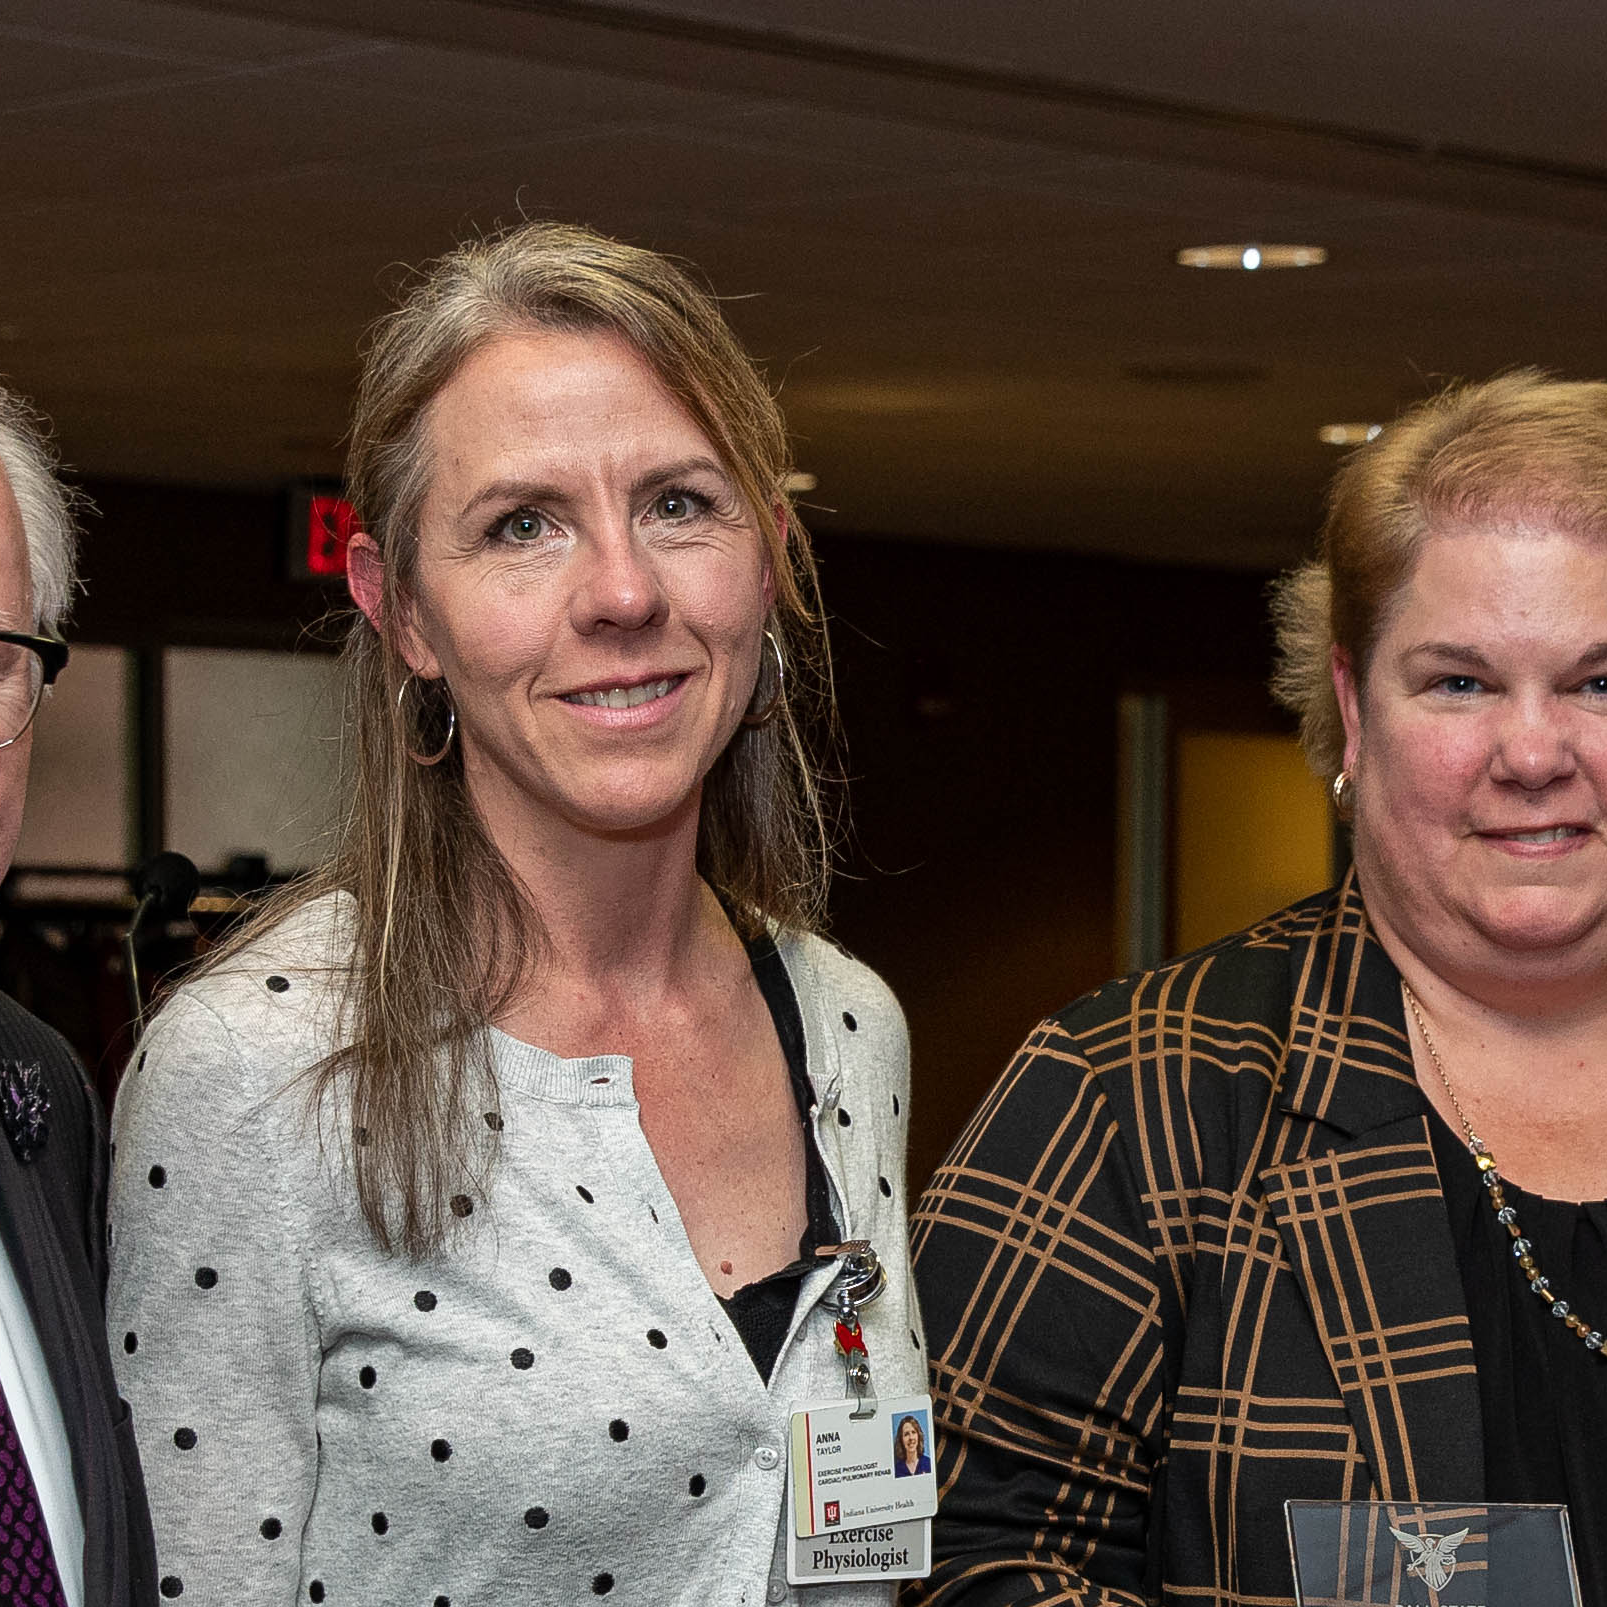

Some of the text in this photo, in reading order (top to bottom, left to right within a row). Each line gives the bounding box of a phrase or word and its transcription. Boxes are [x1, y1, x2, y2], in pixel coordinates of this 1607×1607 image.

[816, 1432, 841, 1445] ANNA
[816, 1445, 841, 1456] TAYLOR
[828, 1526, 894, 1544] Exercise
[812, 1546, 909, 1574] Physiologist
